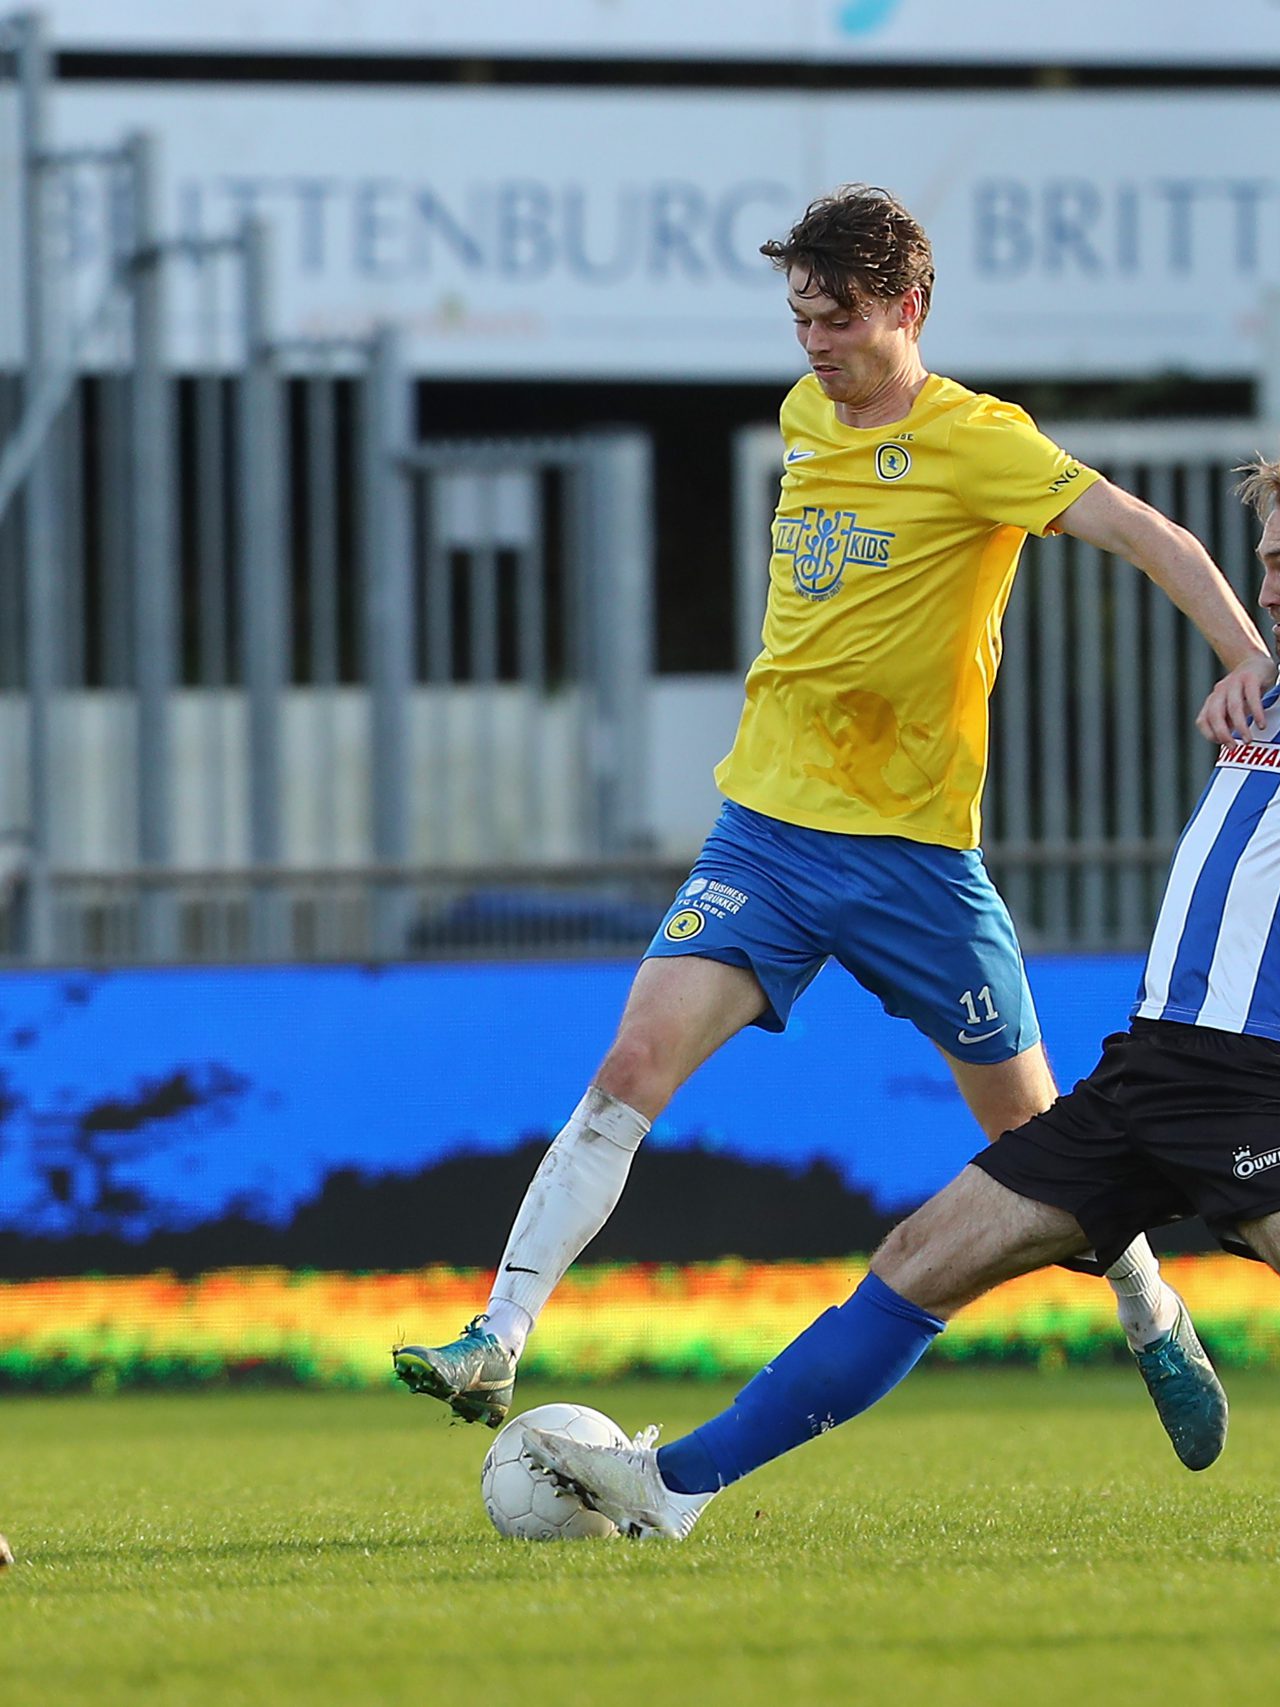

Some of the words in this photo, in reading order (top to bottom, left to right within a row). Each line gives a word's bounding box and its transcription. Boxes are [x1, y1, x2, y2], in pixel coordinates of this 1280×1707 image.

[1049, 468, 1080, 492] ING
[851, 533, 890, 562] KIDS
[700, 892, 740, 915] DRUKKER
[708, 880, 748, 904] BUSINESS
[960, 985, 999, 1025] 11
